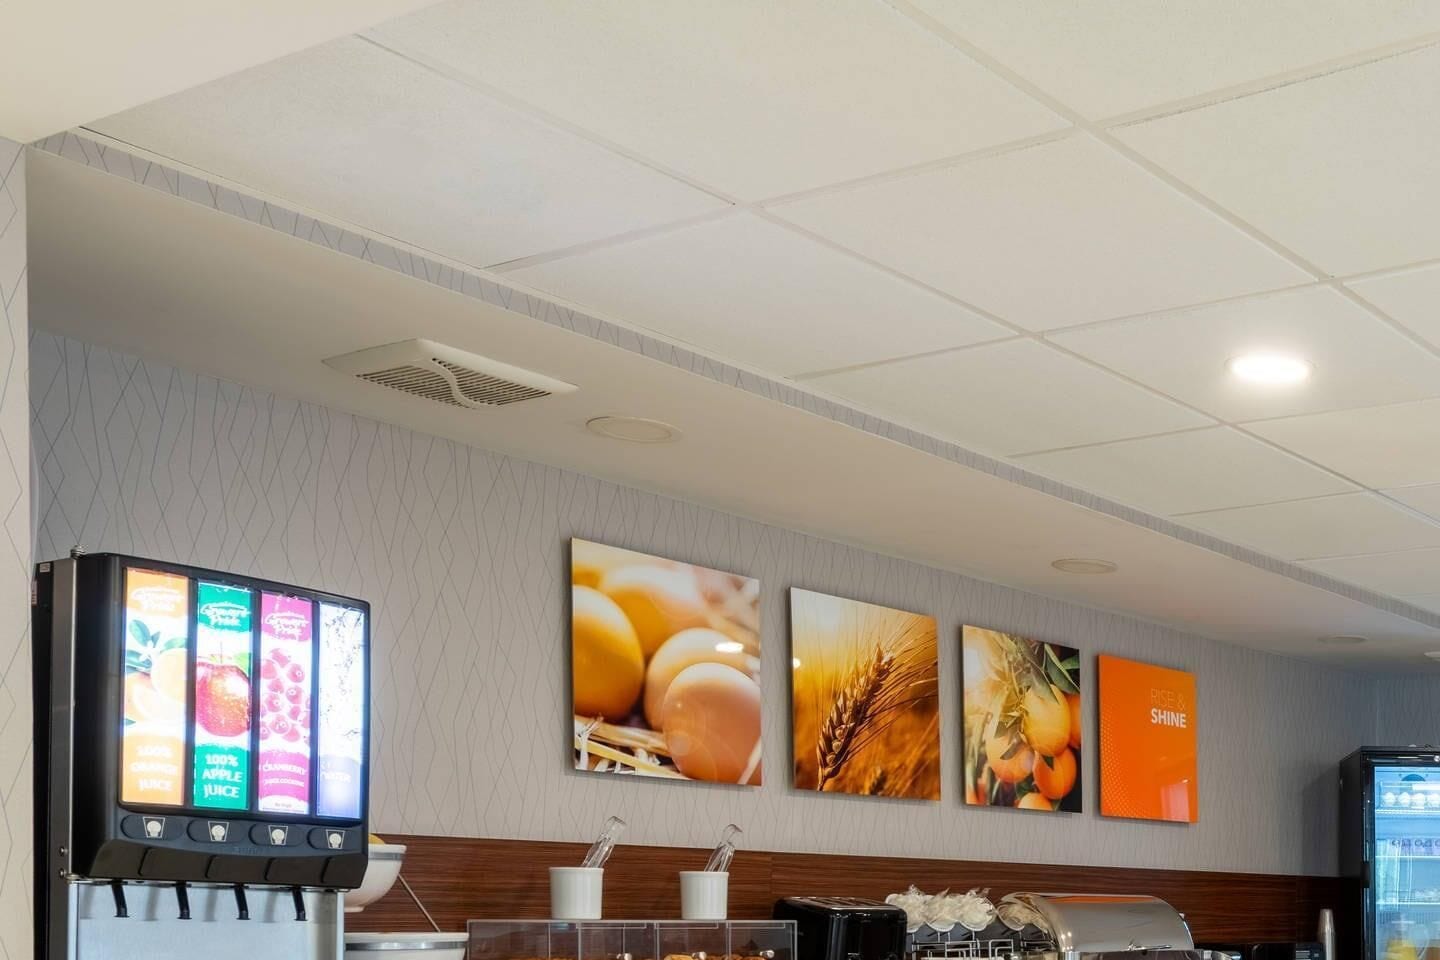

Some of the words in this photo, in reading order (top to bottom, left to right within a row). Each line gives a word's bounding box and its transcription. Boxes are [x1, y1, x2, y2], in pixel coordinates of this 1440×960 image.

[1151, 688, 1174, 709] RISE
[1151, 708, 1186, 728] SHINE
[205, 754, 239, 767] 100%
[202, 768, 243, 782] APPLE
[203, 783, 240, 798] JUICE
